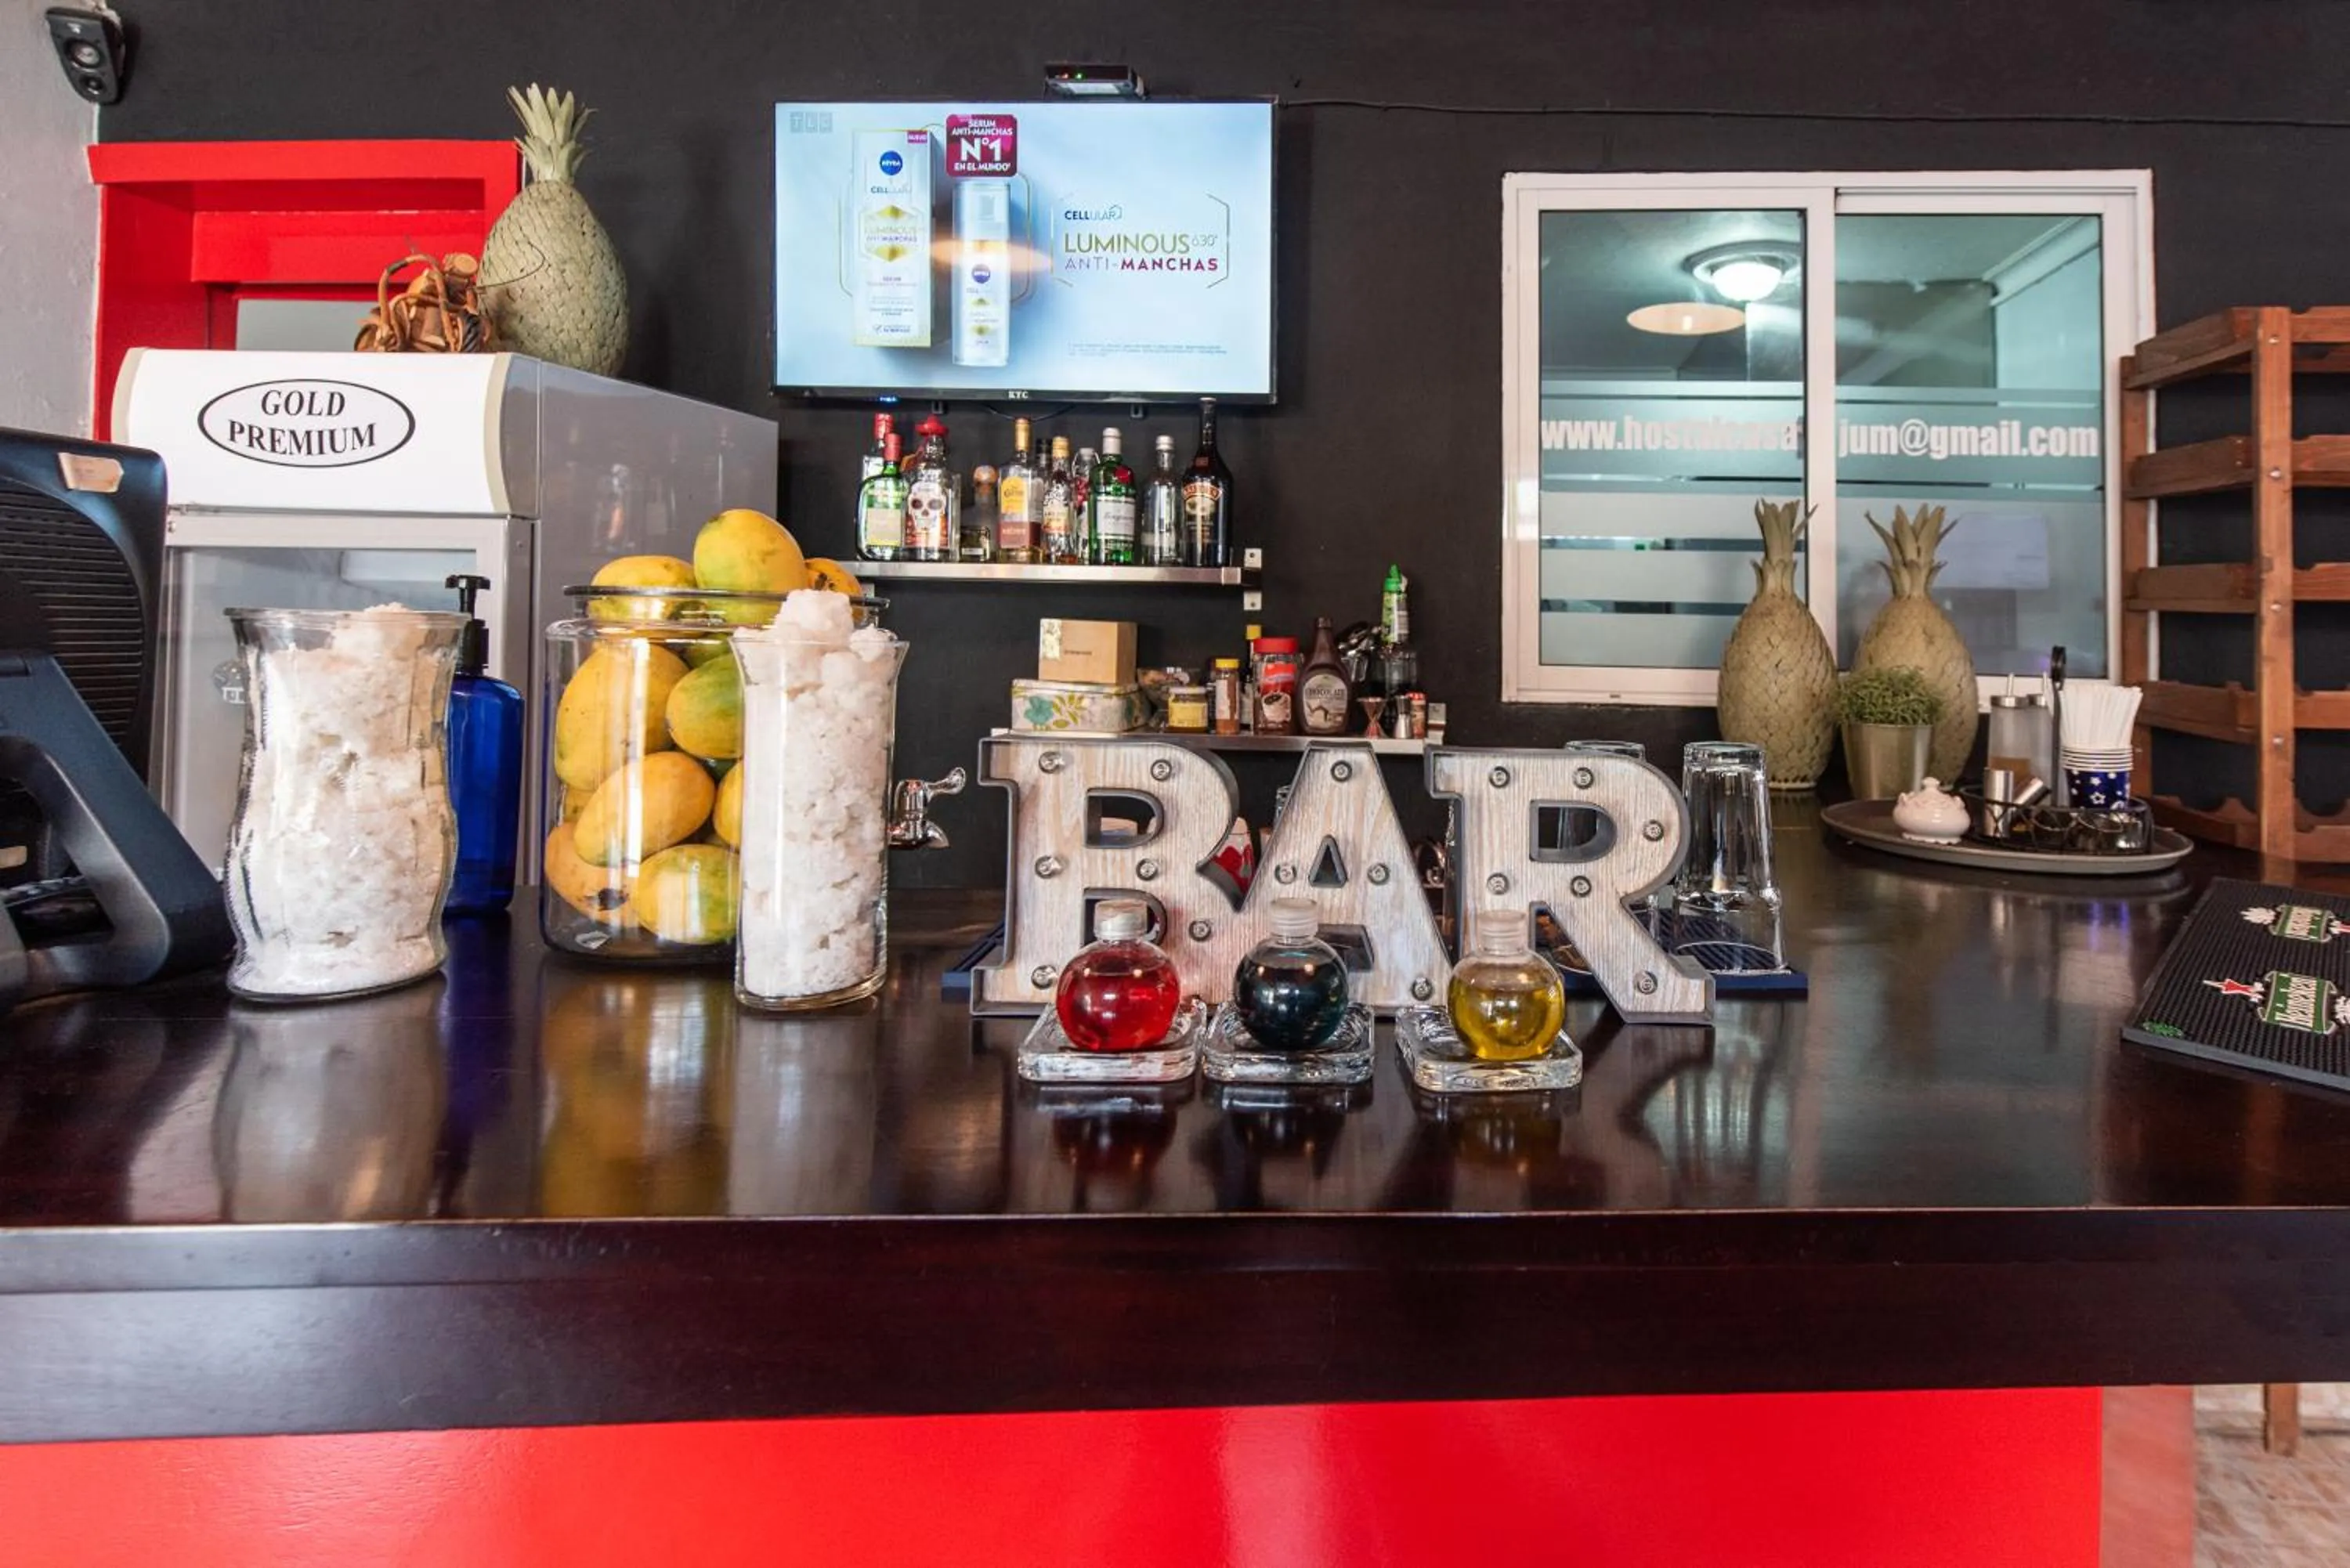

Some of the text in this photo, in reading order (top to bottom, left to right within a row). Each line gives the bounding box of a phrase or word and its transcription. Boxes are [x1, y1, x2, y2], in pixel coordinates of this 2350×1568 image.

[953, 162, 966, 172] EN
[967, 162, 977, 172] EL
[1065, 233, 1191, 255] LUMINOUS
[261, 389, 346, 417] GOLD
[227, 418, 377, 457] PREMIUM
[970, 735, 1716, 1026] BAR
